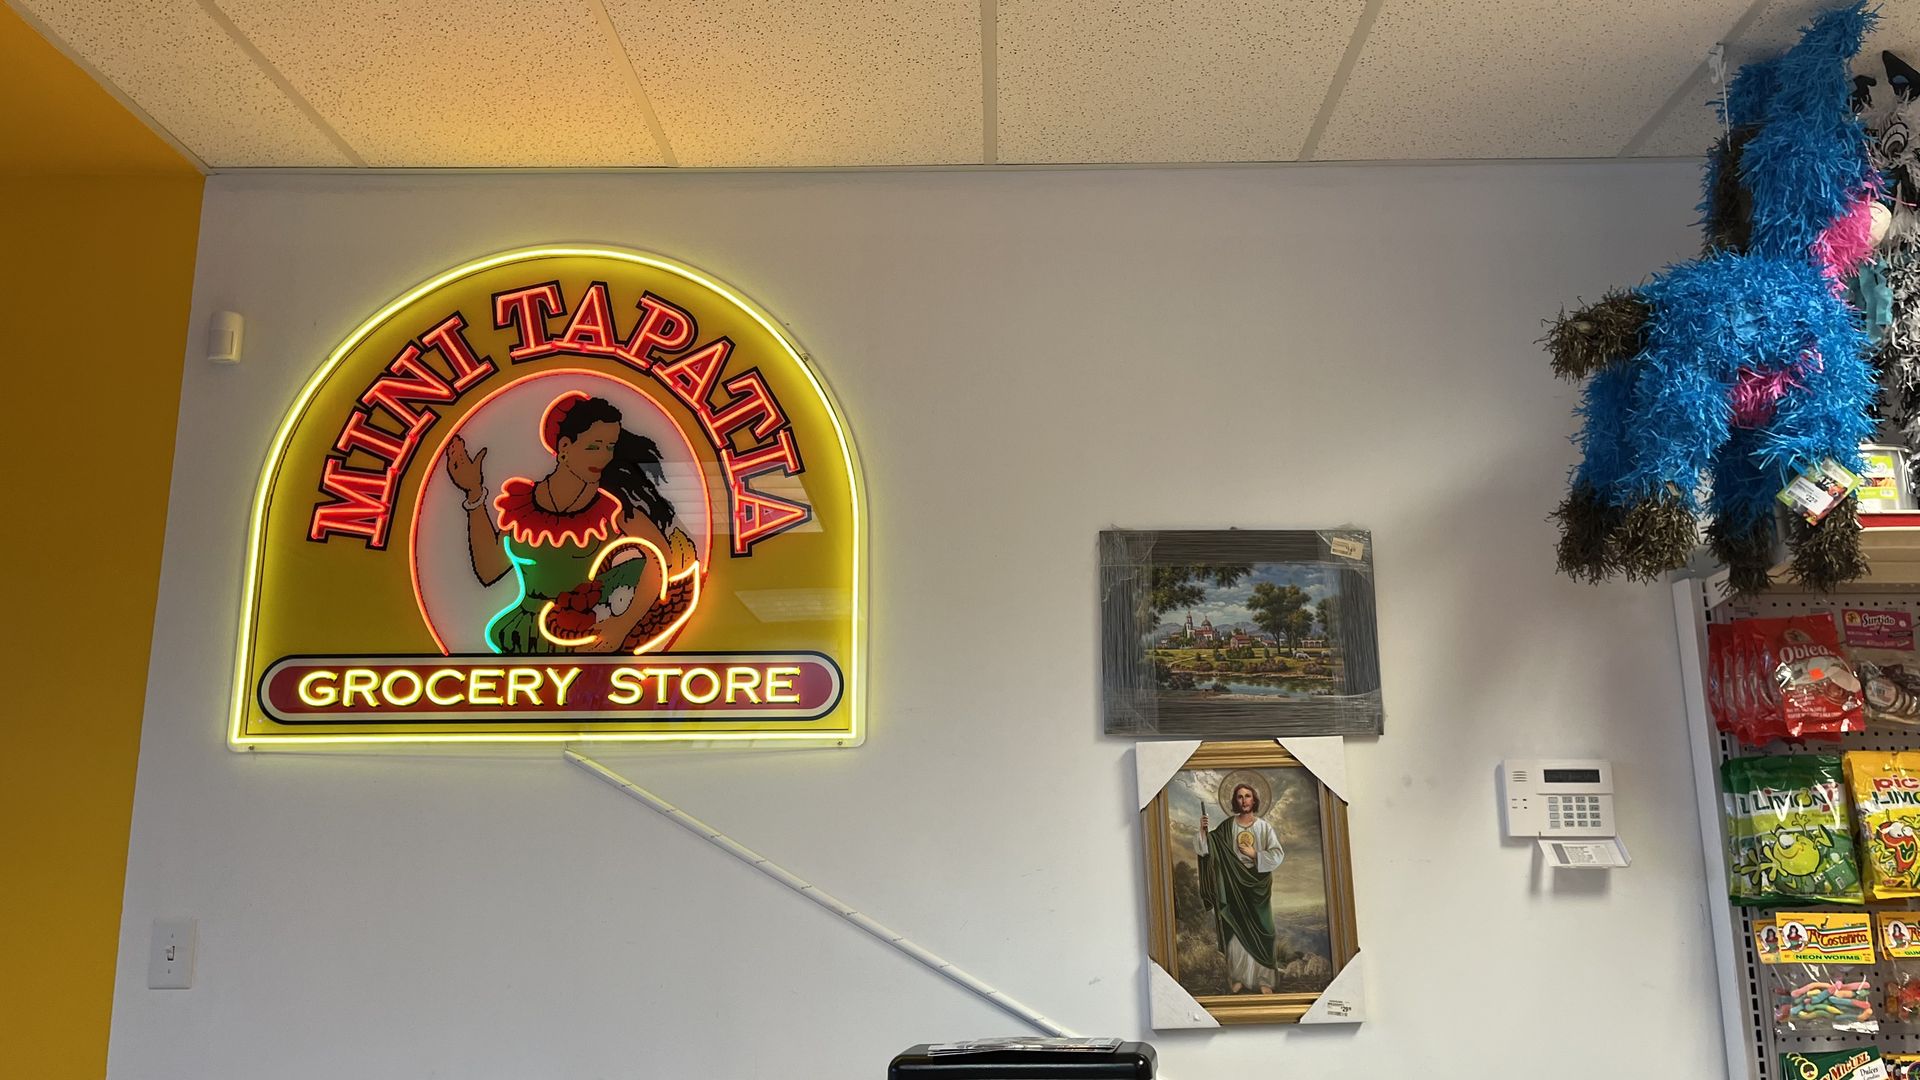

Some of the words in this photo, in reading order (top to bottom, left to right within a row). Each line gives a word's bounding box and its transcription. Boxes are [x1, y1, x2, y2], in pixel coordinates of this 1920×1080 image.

[308, 312, 499, 551] MINI
[493, 281, 811, 557] TAPATIA
[1862, 613, 1896, 628] Surtido
[298, 667, 581, 708] GROCERY
[608, 665, 802, 706] STORE
[1795, 953, 1822, 961] NEON
